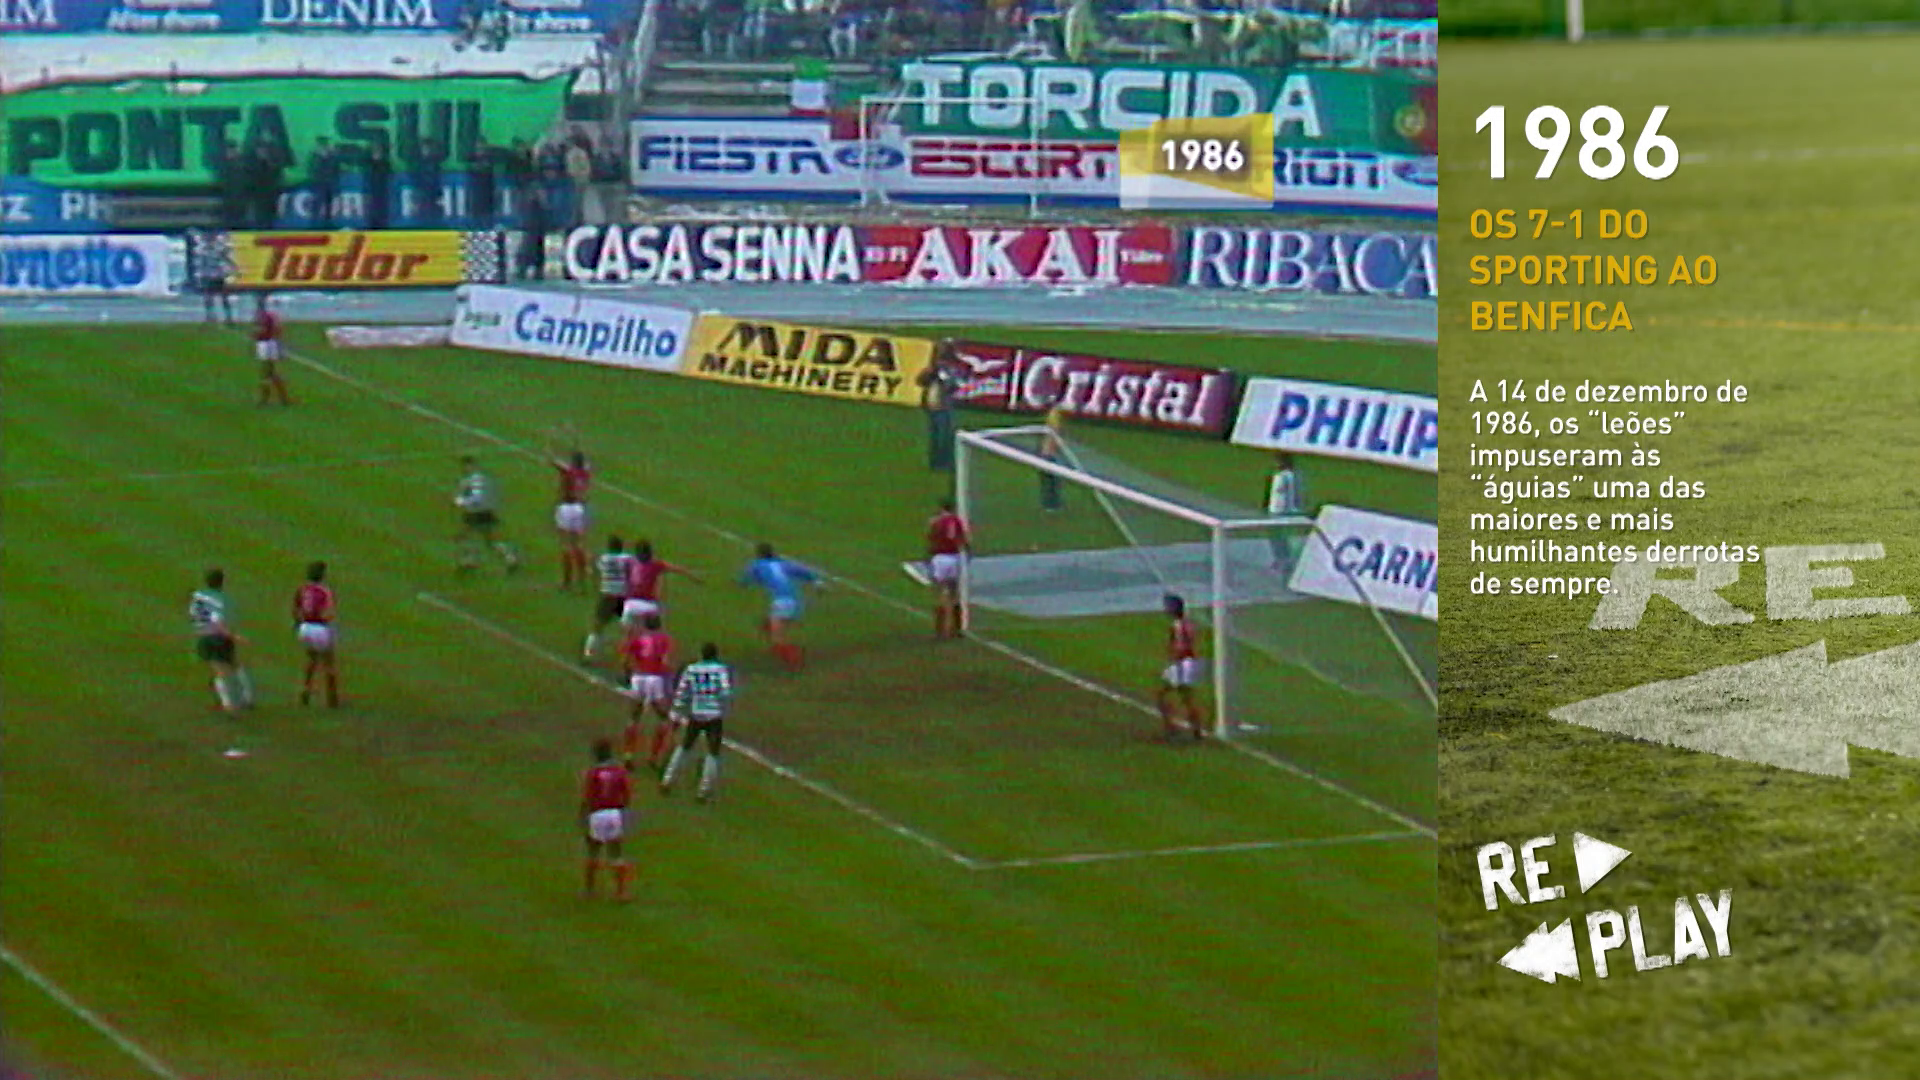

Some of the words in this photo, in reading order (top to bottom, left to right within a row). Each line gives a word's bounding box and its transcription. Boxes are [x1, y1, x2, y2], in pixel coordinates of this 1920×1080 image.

[260, 0, 438, 26] DENIM
[902, 62, 1322, 138] TORCIDA
[7, 103, 295, 174] PONTA
[334, 100, 483, 168] SUL
[638, 135, 831, 175] FIESTA
[910, 141, 1120, 180] ESCORT
[0, 238, 147, 288] rnetto
[254, 235, 429, 283] Tudor
[565, 225, 695, 282] CASA
[702, 225, 860, 282] SENNA
[906, 227, 1122, 285] AKAI
[1187, 226, 1438, 296] RIBACA
[515, 303, 677, 359] Campilho
[718, 322, 897, 371] MIDA
[700, 354, 903, 398] MACHINERY
[1022, 356, 1206, 425] Cristal
[1271, 391, 1438, 458] PHILIP
[1333, 535, 1438, 592] CARN
